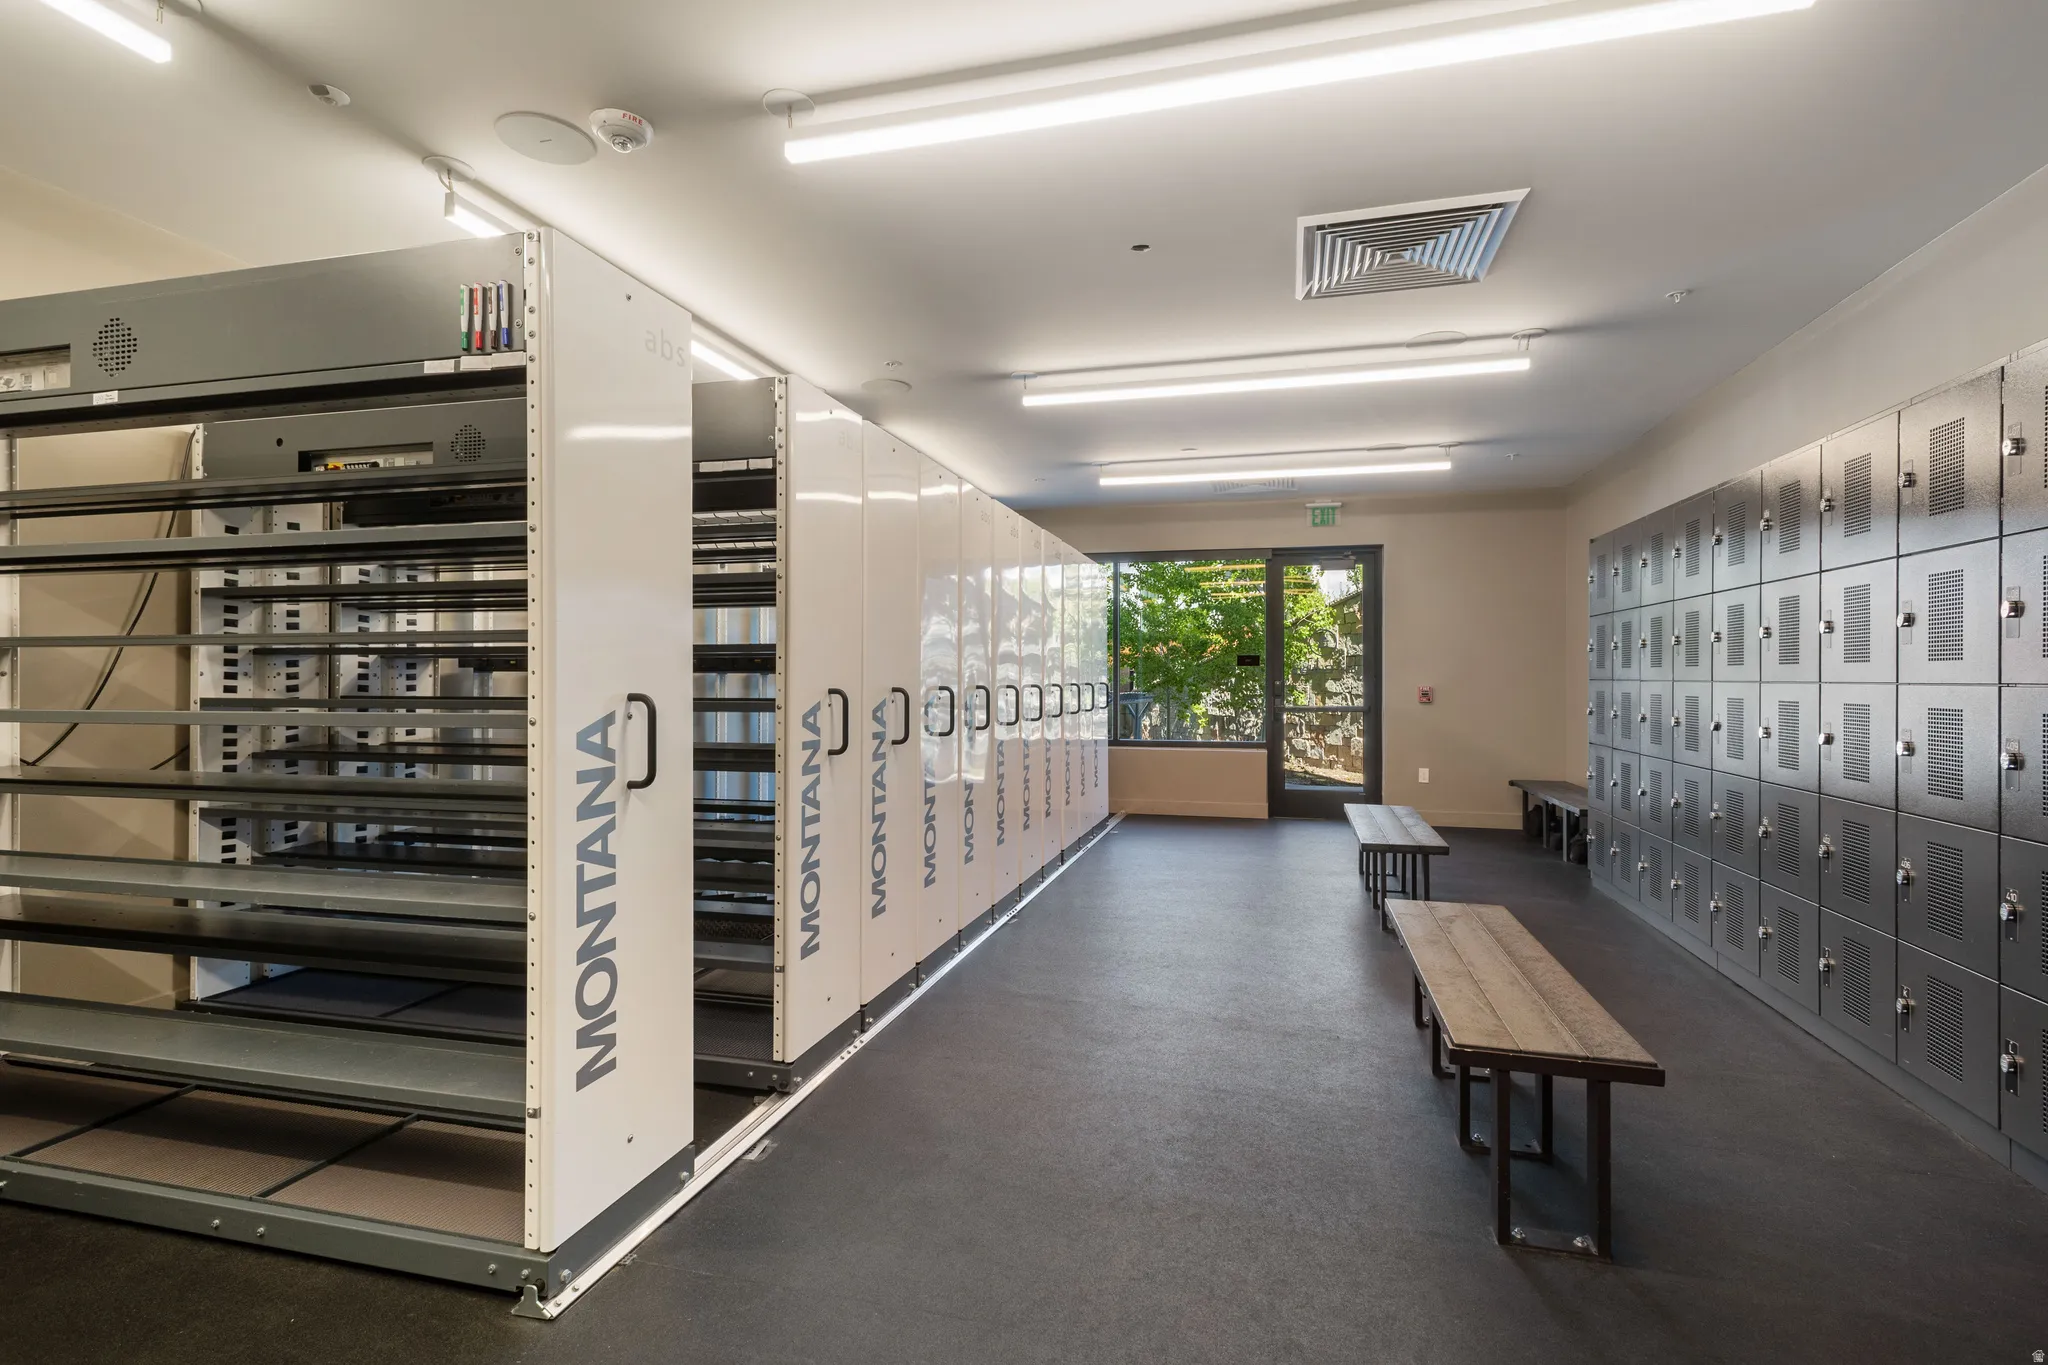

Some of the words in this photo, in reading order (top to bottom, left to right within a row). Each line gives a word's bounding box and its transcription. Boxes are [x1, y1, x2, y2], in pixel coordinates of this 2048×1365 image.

[622, 112, 643, 126] FIRE
[645, 328, 685, 367] abs
[1312, 506, 1336, 526] EXIT
[996, 740, 1005, 847] MONTA
[871, 697, 887, 920] MONTANA
[800, 700, 821, 961] MONTANA
[1901, 860, 1911, 870] 406
[575, 709, 618, 1092] MONTANA
[2006, 892, 2017, 902] 410
[2008, 1043, 2015, 1055] L
